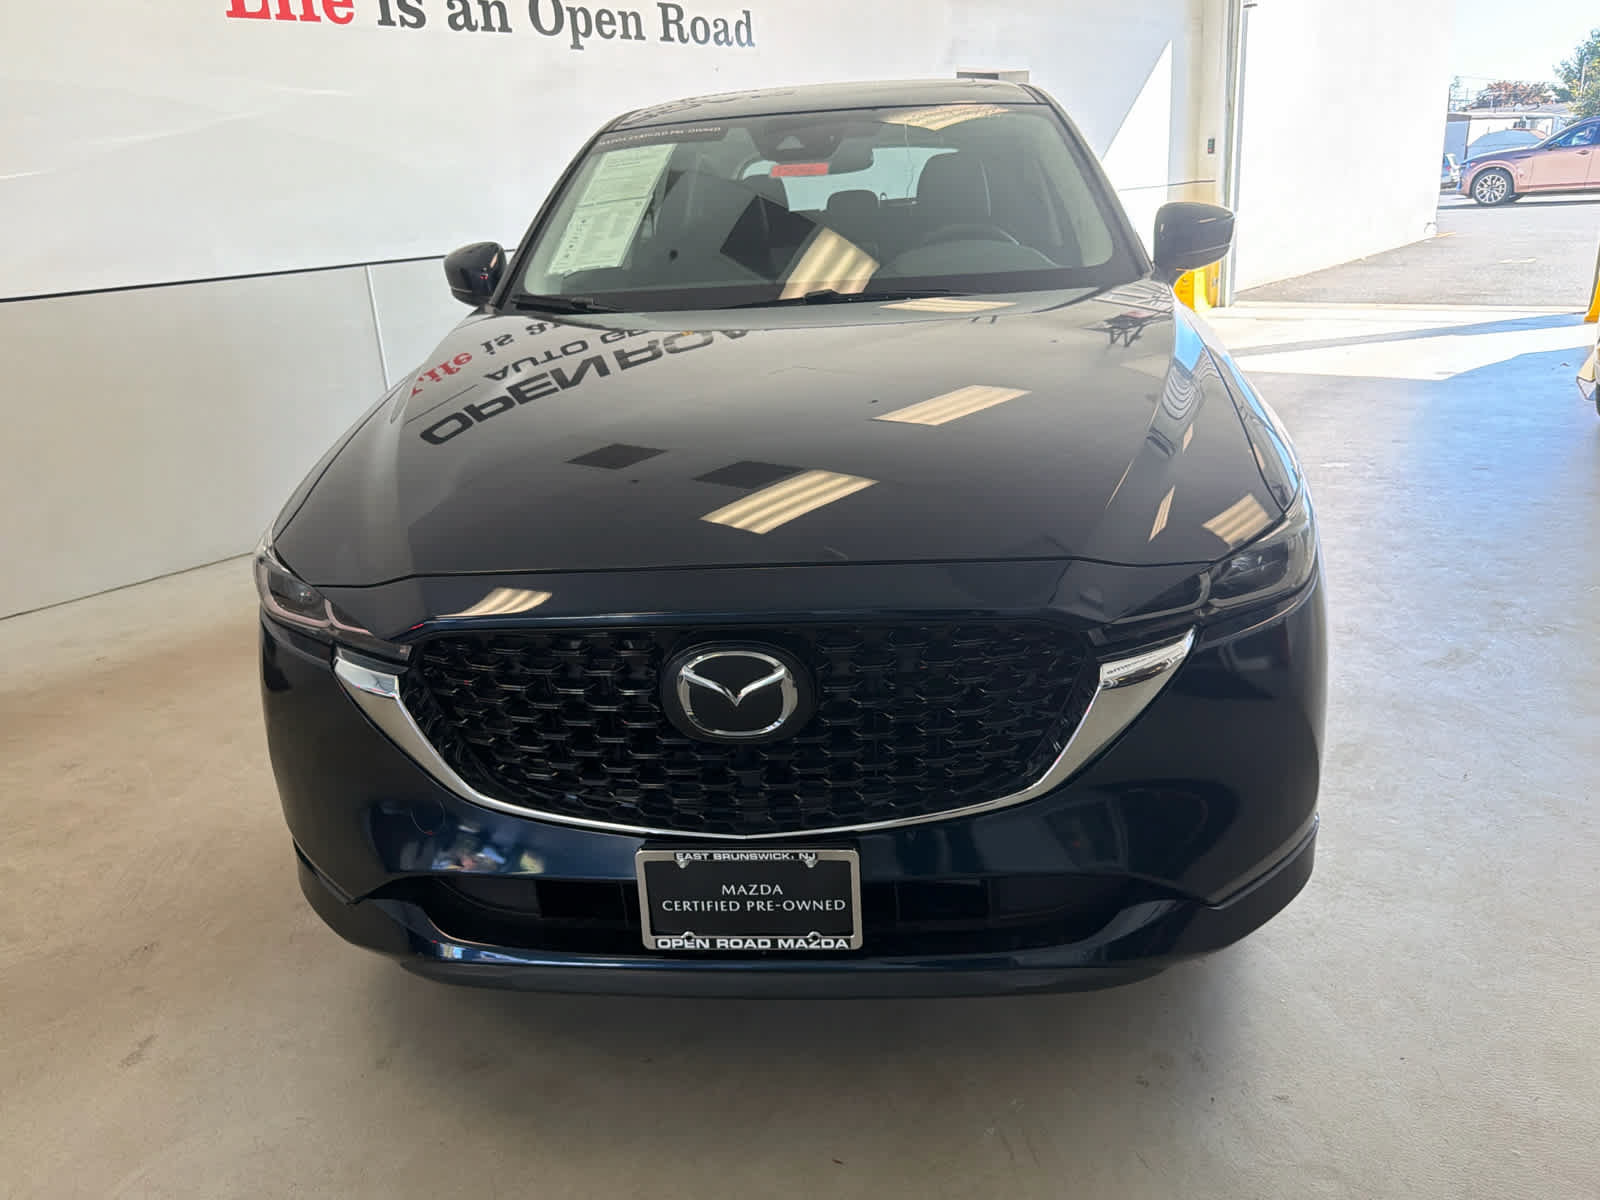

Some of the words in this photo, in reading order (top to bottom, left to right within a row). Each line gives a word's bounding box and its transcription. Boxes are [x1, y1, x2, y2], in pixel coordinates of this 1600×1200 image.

[377, 0, 427, 29] is
[447, 0, 513, 33] an
[528, 0, 646, 50] Open
[656, 2, 756, 48] Road
[675, 852, 709, 861] EAST
[712, 852, 795, 861] BRUNSWICK,
[799, 852, 816, 861] NJ
[721, 884, 784, 896] MAZDA
[662, 900, 741, 912] CERTIFIED
[746, 899, 847, 912] PRE-OWNED
[657, 938, 711, 949] OPEN
[716, 938, 773, 949] ROAD
[777, 937, 850, 949] MAZDA
